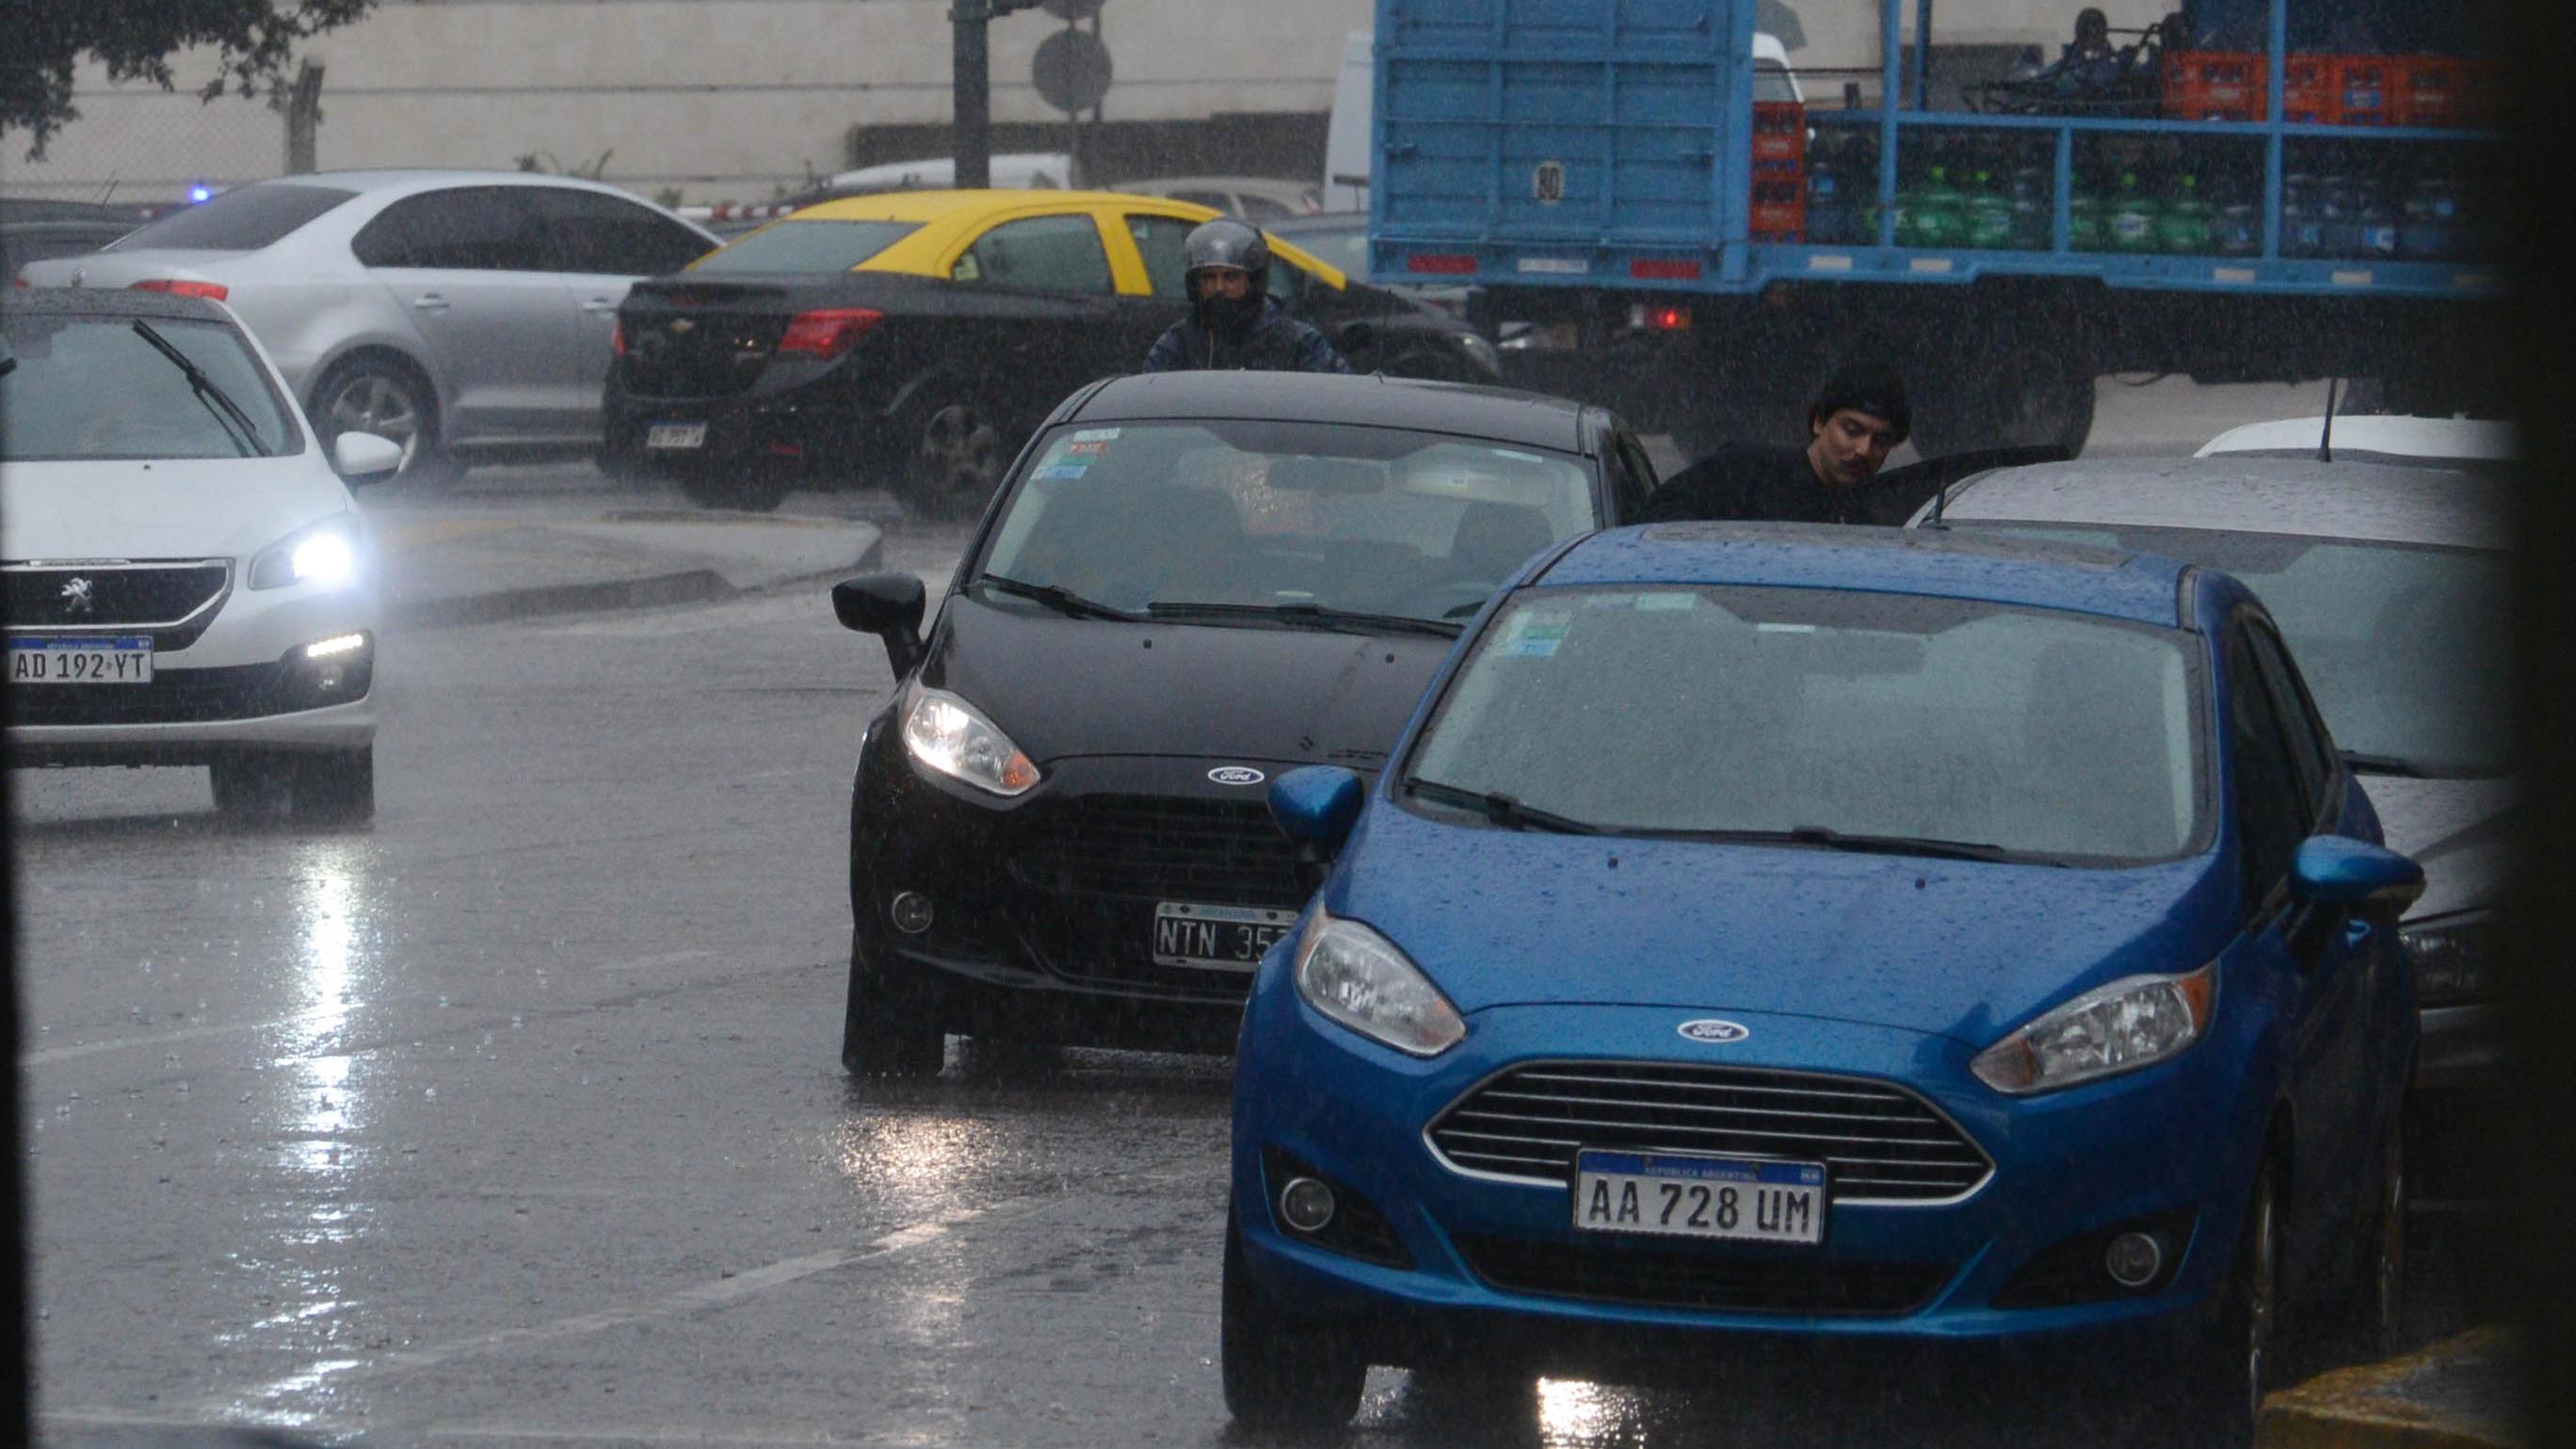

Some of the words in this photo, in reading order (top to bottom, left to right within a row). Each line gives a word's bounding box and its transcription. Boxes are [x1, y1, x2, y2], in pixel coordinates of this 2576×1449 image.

[15, 652, 46, 678] AD
[56, 652, 104, 678] 192
[114, 652, 145, 678] YT
[1159, 919, 1216, 958] NTN
[1235, 925, 1290, 960] 35
[1588, 1179, 1640, 1223] AA
[1660, 1183, 1739, 1230] 728
[1756, 1188, 1811, 1234] UM
